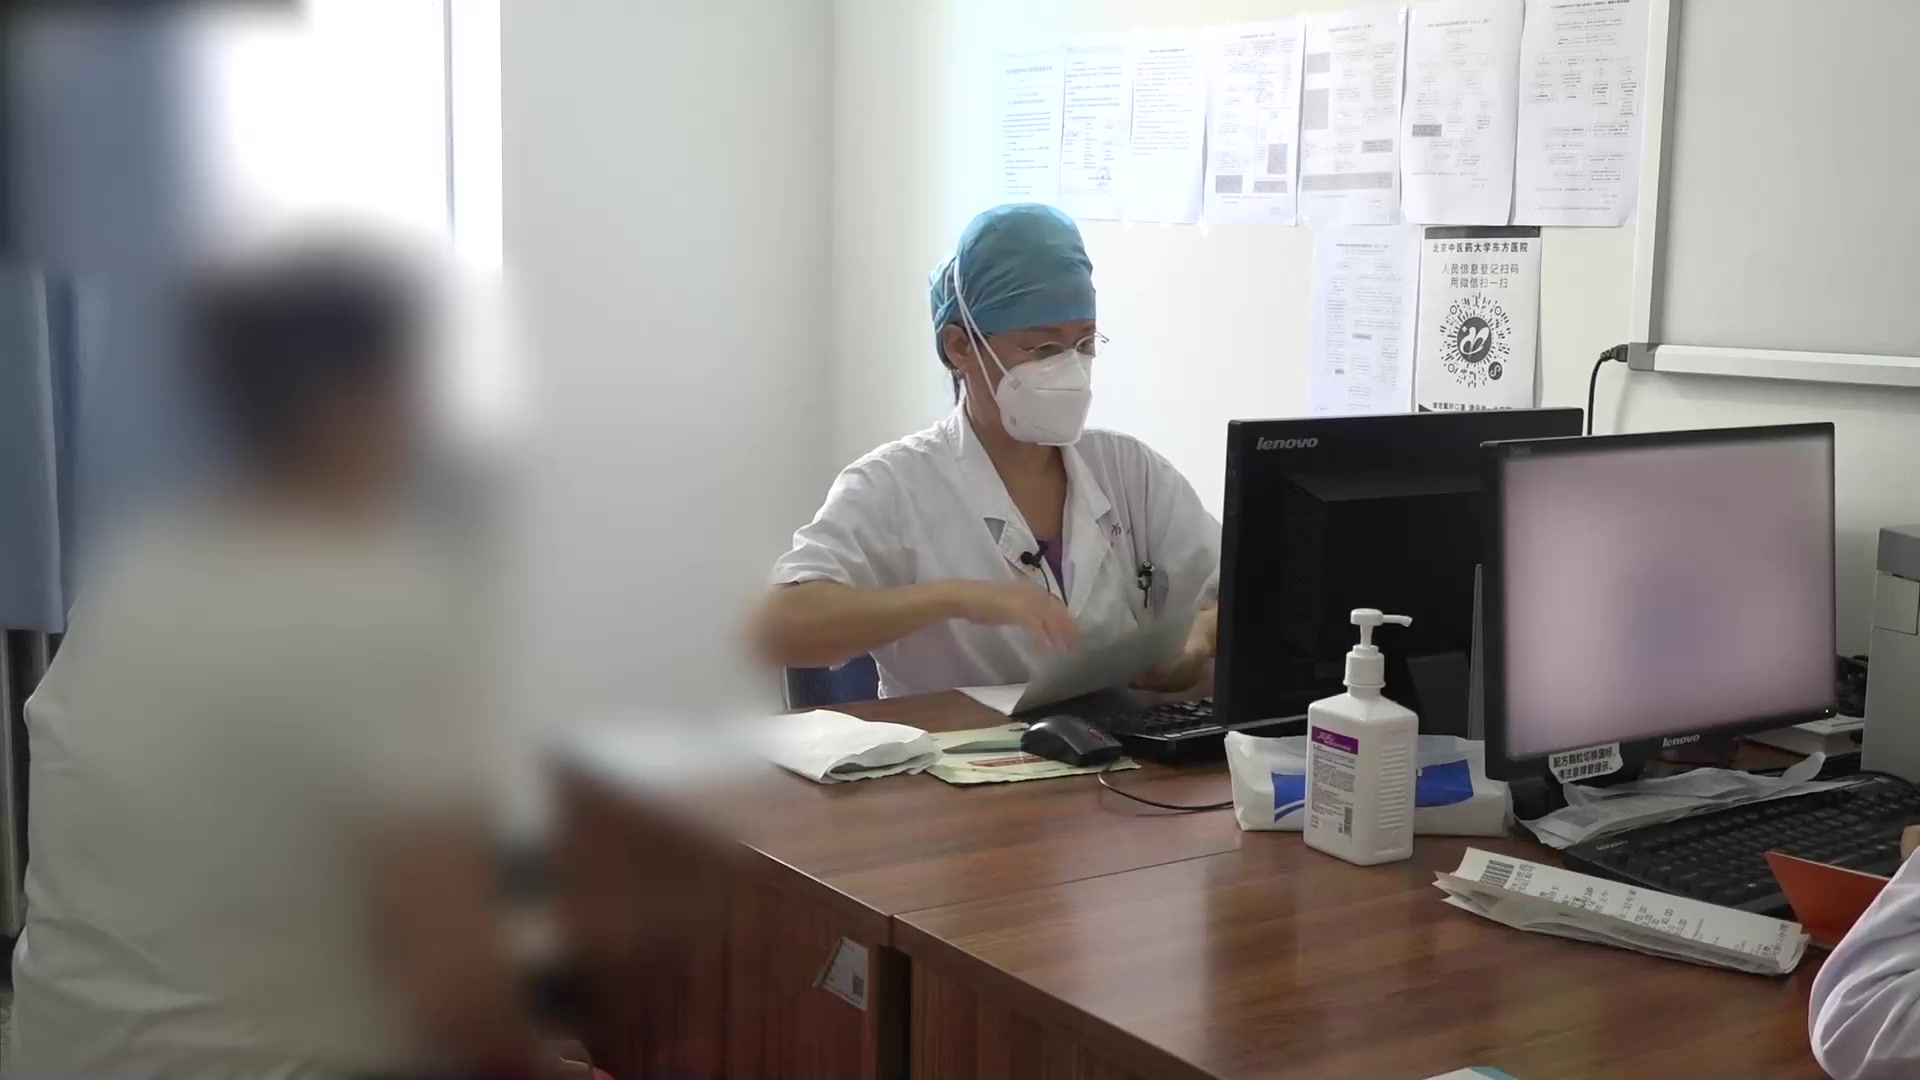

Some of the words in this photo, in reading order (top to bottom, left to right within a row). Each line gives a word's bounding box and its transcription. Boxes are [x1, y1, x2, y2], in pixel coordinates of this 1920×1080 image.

[1432, 242, 1529, 254] 北京中医药大学东方医院
[1441, 263, 1520, 275] 人员信息登记扫码
[1449, 277, 1508, 289] 用微信扫一扫
[1256, 436, 1319, 451] lenovo
[1662, 734, 1701, 748] lenovo
